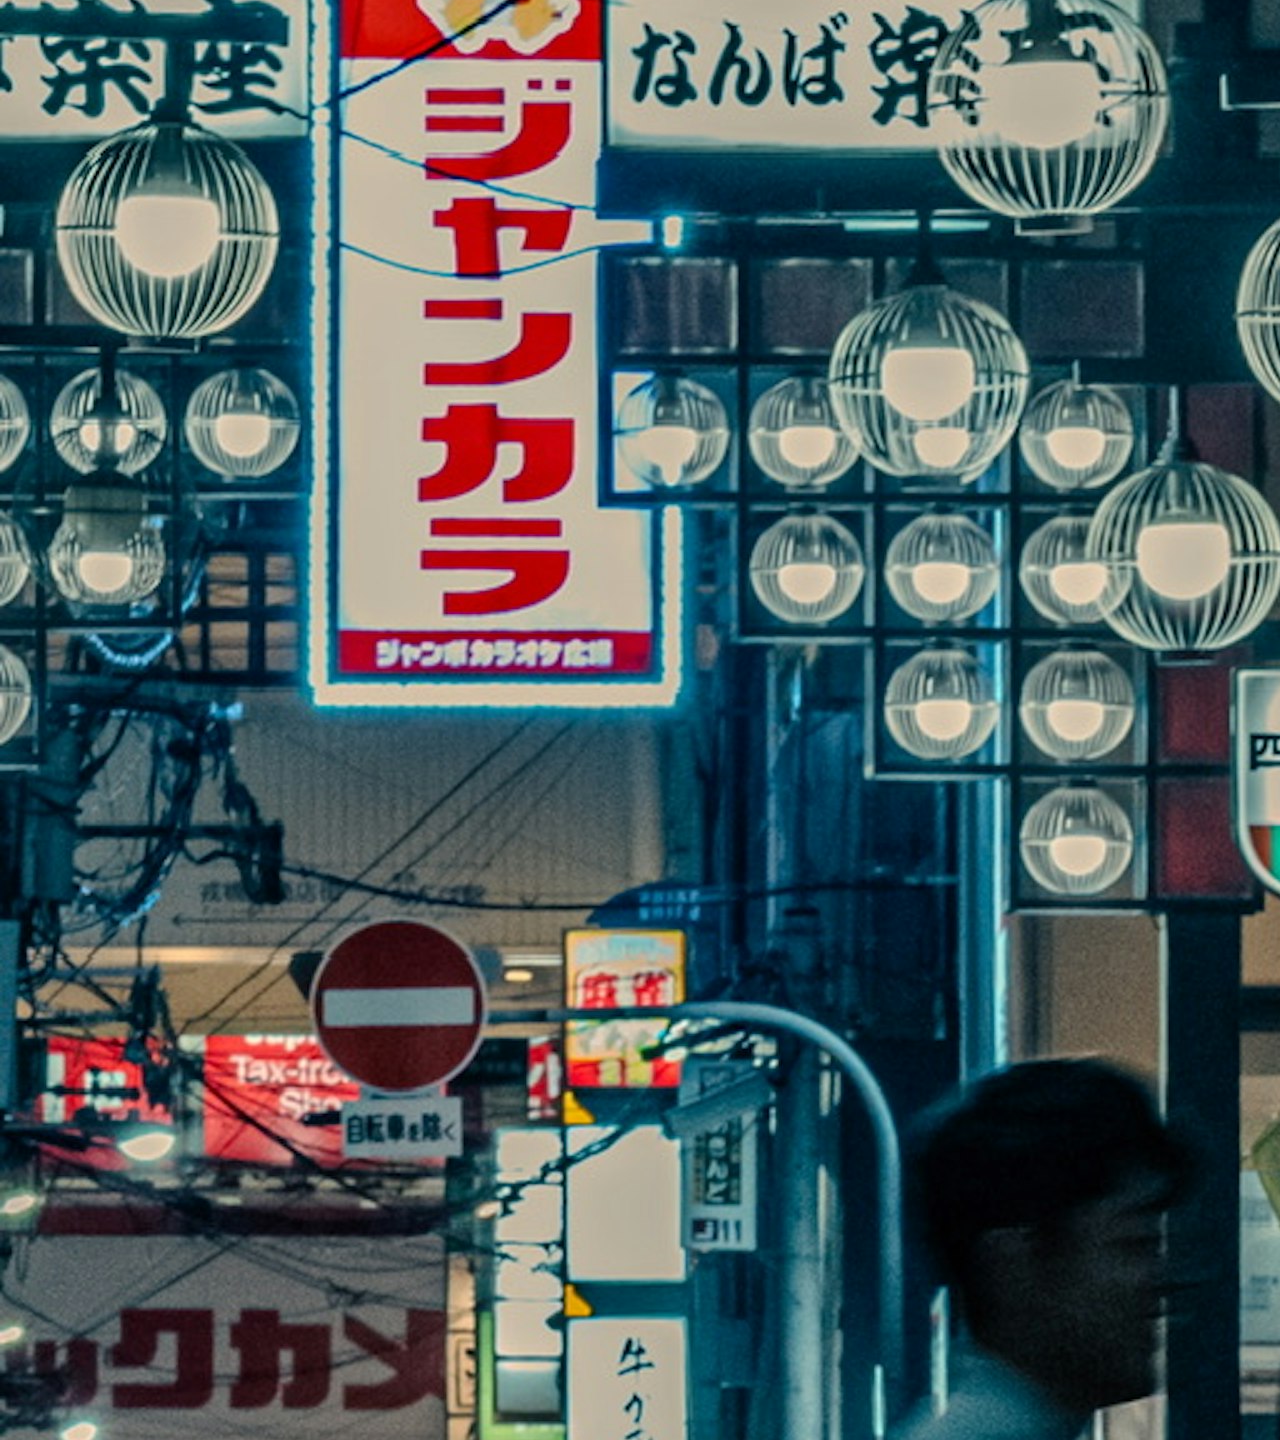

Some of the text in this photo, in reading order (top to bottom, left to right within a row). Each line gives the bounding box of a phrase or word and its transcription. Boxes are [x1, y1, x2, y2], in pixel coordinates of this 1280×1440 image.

[631, 6, 1115, 128] なんば楽
[419, 81, 575, 615] ジャンカラ
